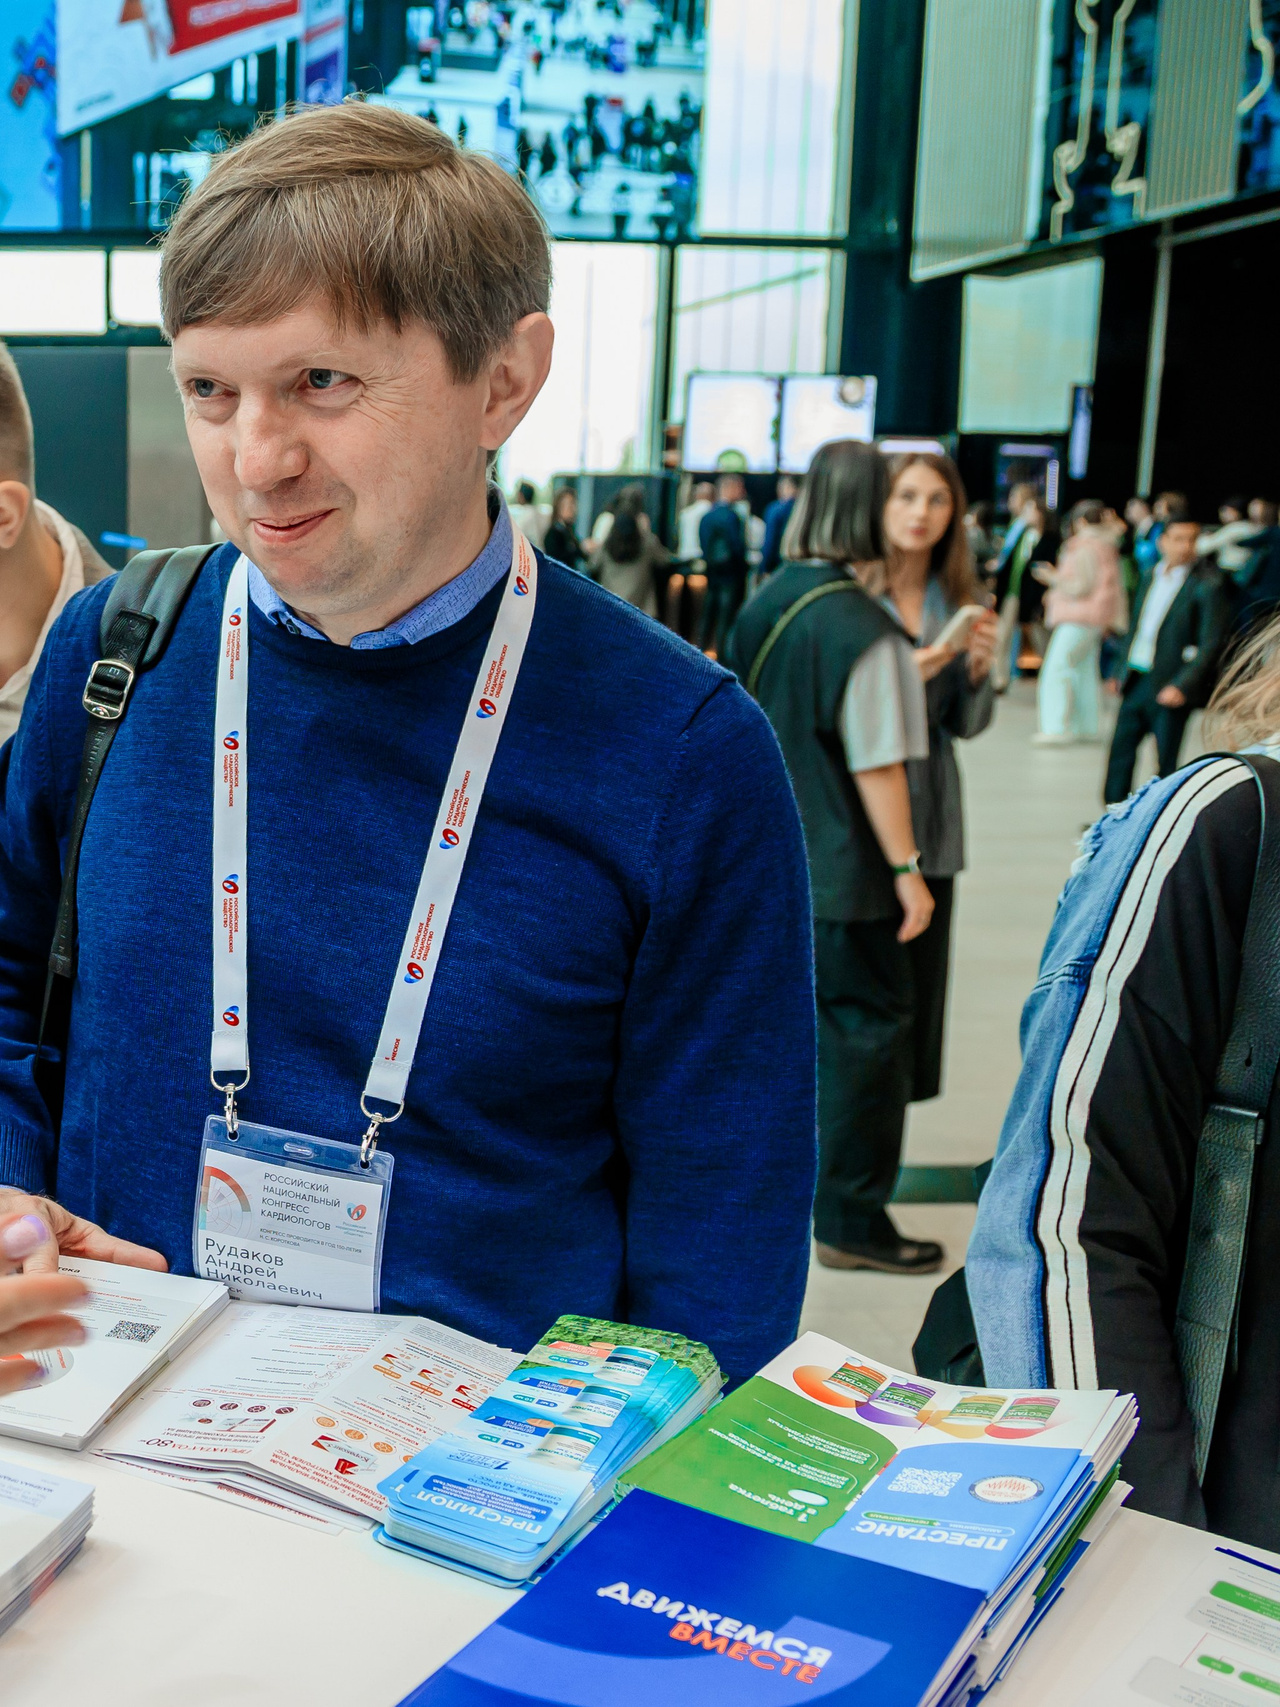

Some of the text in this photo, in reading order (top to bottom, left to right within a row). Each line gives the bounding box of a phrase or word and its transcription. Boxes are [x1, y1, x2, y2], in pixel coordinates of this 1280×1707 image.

[483, 660, 497, 694] РОССИЙСКОЕ
[489, 644, 508, 696] КАРДИОЛОГИЧЕСКОЕ
[495, 670, 507, 698] ОБЩЕСТВО
[446, 789, 460, 824] РОССИЙСКОЕ
[452, 770, 470, 826] КАРДИОЛОГИЧЕСКОЕ
[458, 797, 469, 827] ОБЩЕСТВО
[411, 922, 424, 958] РОССИЙСКОЕ
[416, 903, 435, 960] КАРДИОЛОГИЧЕСКОЕ
[422, 931, 434, 961] ОБЩЕСТВО
[263, 1185, 340, 1208] НАЦИОНАЛЬНЫЙ
[264, 1172, 329, 1193] РОССИЙСКИЙ
[261, 1209, 331, 1230] КАРДИОЛОГОВ
[262, 1197, 310, 1214] КОНГРЕСС
[260, 1228, 285, 1237] КОНГРЕСС
[271, 1237, 300, 1246] КОРОТКОВА
[205, 1238, 284, 1266] Рудаков
[205, 1254, 277, 1279] Андрей
[207, 1267, 322, 1300] Николаевич
[144, 1437, 175, 1447] 80
[494, 1461, 510, 1470] 1
[708, 1428, 842, 1489] СПОСОБСТВУЕТ ЭФФЕКТИВНОМУ
[767, 1452, 783, 1463] БЕЗ
[784, 1460, 797, 1469] АД
[289, 1455, 389, 1500] УСЛОВЛЕННЫМ КОНТРОЛЕМ
[344, 1491, 384, 1511] ПРЕПАРАТ
[416, 1490, 542, 1534] ПРЕСТИЛОЛ
[487, 1503, 536, 1520] ЕДИНСТВЕННАЯ
[728, 1483, 808, 1522] 1 таблетка
[856, 1521, 1008, 1551] ПРЕСТАНС
[596, 1580, 833, 1668] ДВИЖЕМСЯ
[669, 1621, 821, 1685] ВМЕСТЕ
